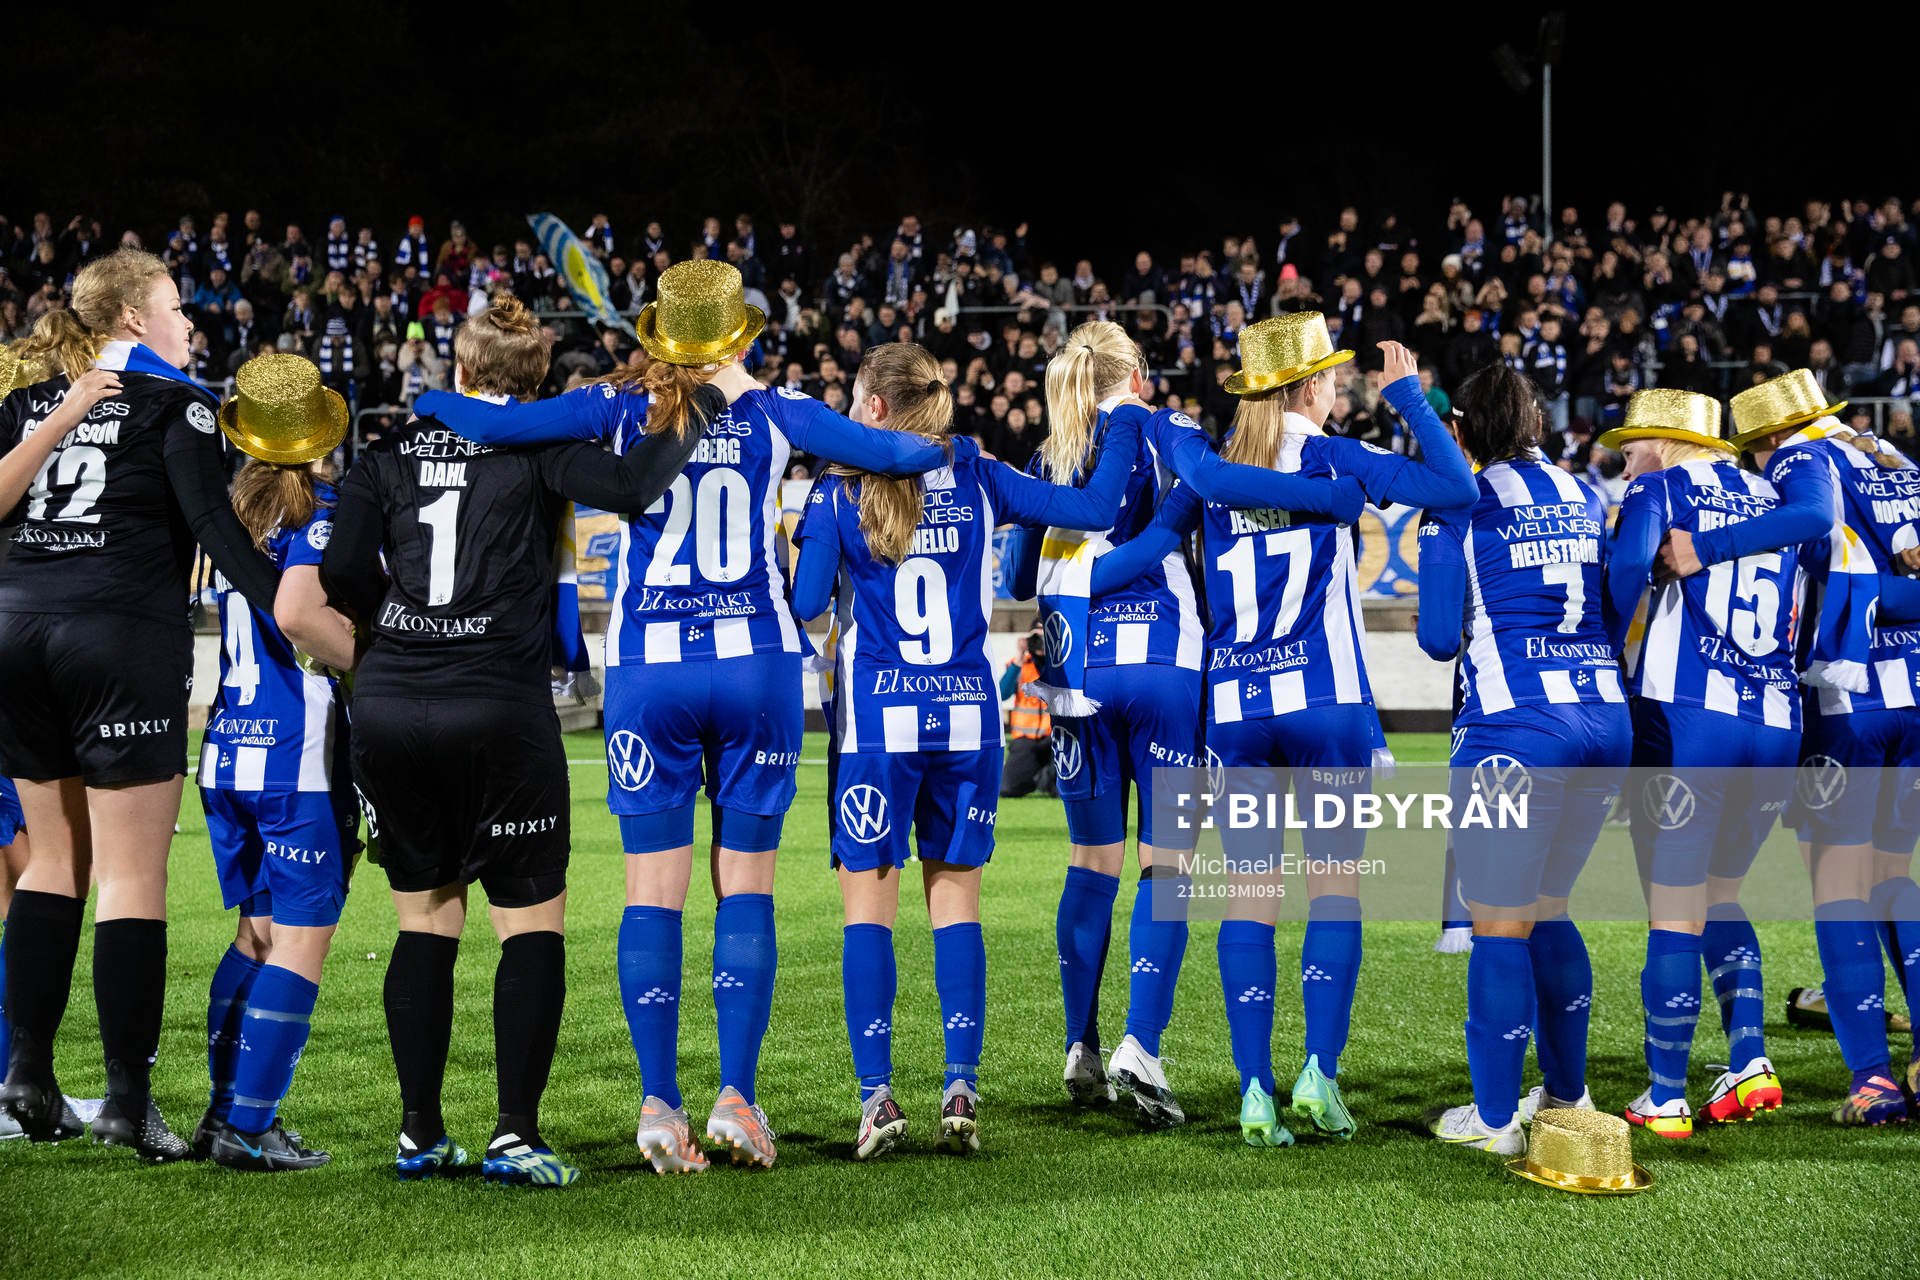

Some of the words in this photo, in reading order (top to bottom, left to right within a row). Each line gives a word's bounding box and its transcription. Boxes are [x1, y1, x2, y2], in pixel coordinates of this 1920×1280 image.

[27, 445, 107, 524] 12
[419, 460, 468, 487] DAHL
[1701, 485, 1777, 509] NORDIC
[1229, 507, 1292, 536] JENSEN
[1514, 503, 1587, 521] NORDIC
[644, 467, 751, 586] 20
[1496, 518, 1601, 541] WELLNESS
[418, 490, 461, 607] 1
[906, 526, 960, 555] NELLO
[1509, 535, 1600, 569] HELLSTRÖM
[1216, 528, 1313, 643] 17
[1542, 562, 1586, 634] 7
[665, 592, 752, 610] KONTAKT
[715, 605, 756, 616] INSTALCO
[894, 557, 953, 666] 9
[1704, 552, 1782, 657] 15
[1119, 613, 1159, 621] INSTALCO
[1229, 640, 1307, 668] KONTAKT
[902, 675, 983, 692] KONTAKT
[952, 692, 988, 701] INSTALCO
[99, 717, 171, 739] BRIXLY
[1311, 768, 1366, 788] BRIXLY
[490, 815, 558, 838] BRIXLY
[266, 840, 327, 865] RIXLY
